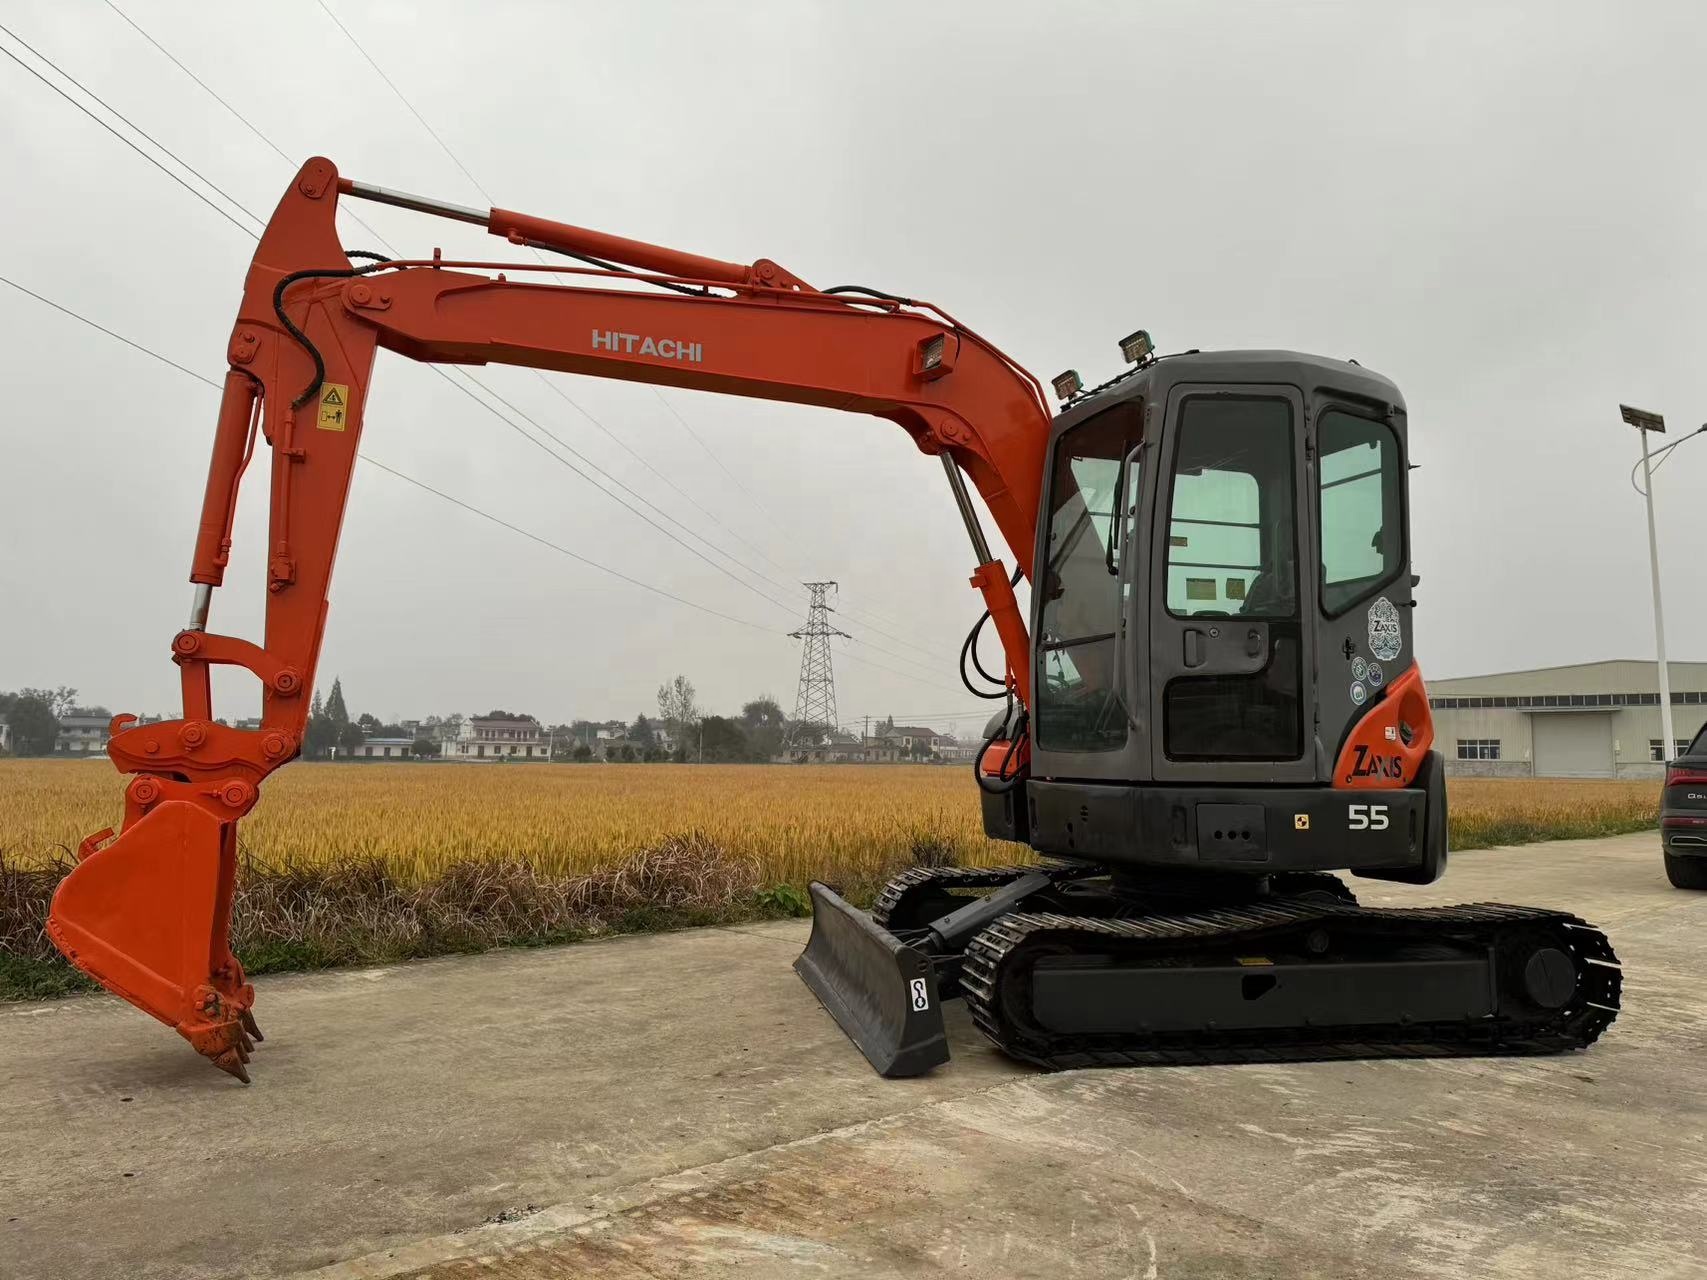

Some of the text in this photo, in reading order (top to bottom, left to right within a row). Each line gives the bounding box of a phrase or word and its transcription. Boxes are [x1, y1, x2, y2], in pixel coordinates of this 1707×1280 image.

[592, 329, 702, 362] HITACHI
[1374, 620, 1398, 633] ZAXIS
[1352, 744, 1402, 782] ZAXIS
[1349, 804, 1389, 830] 55
